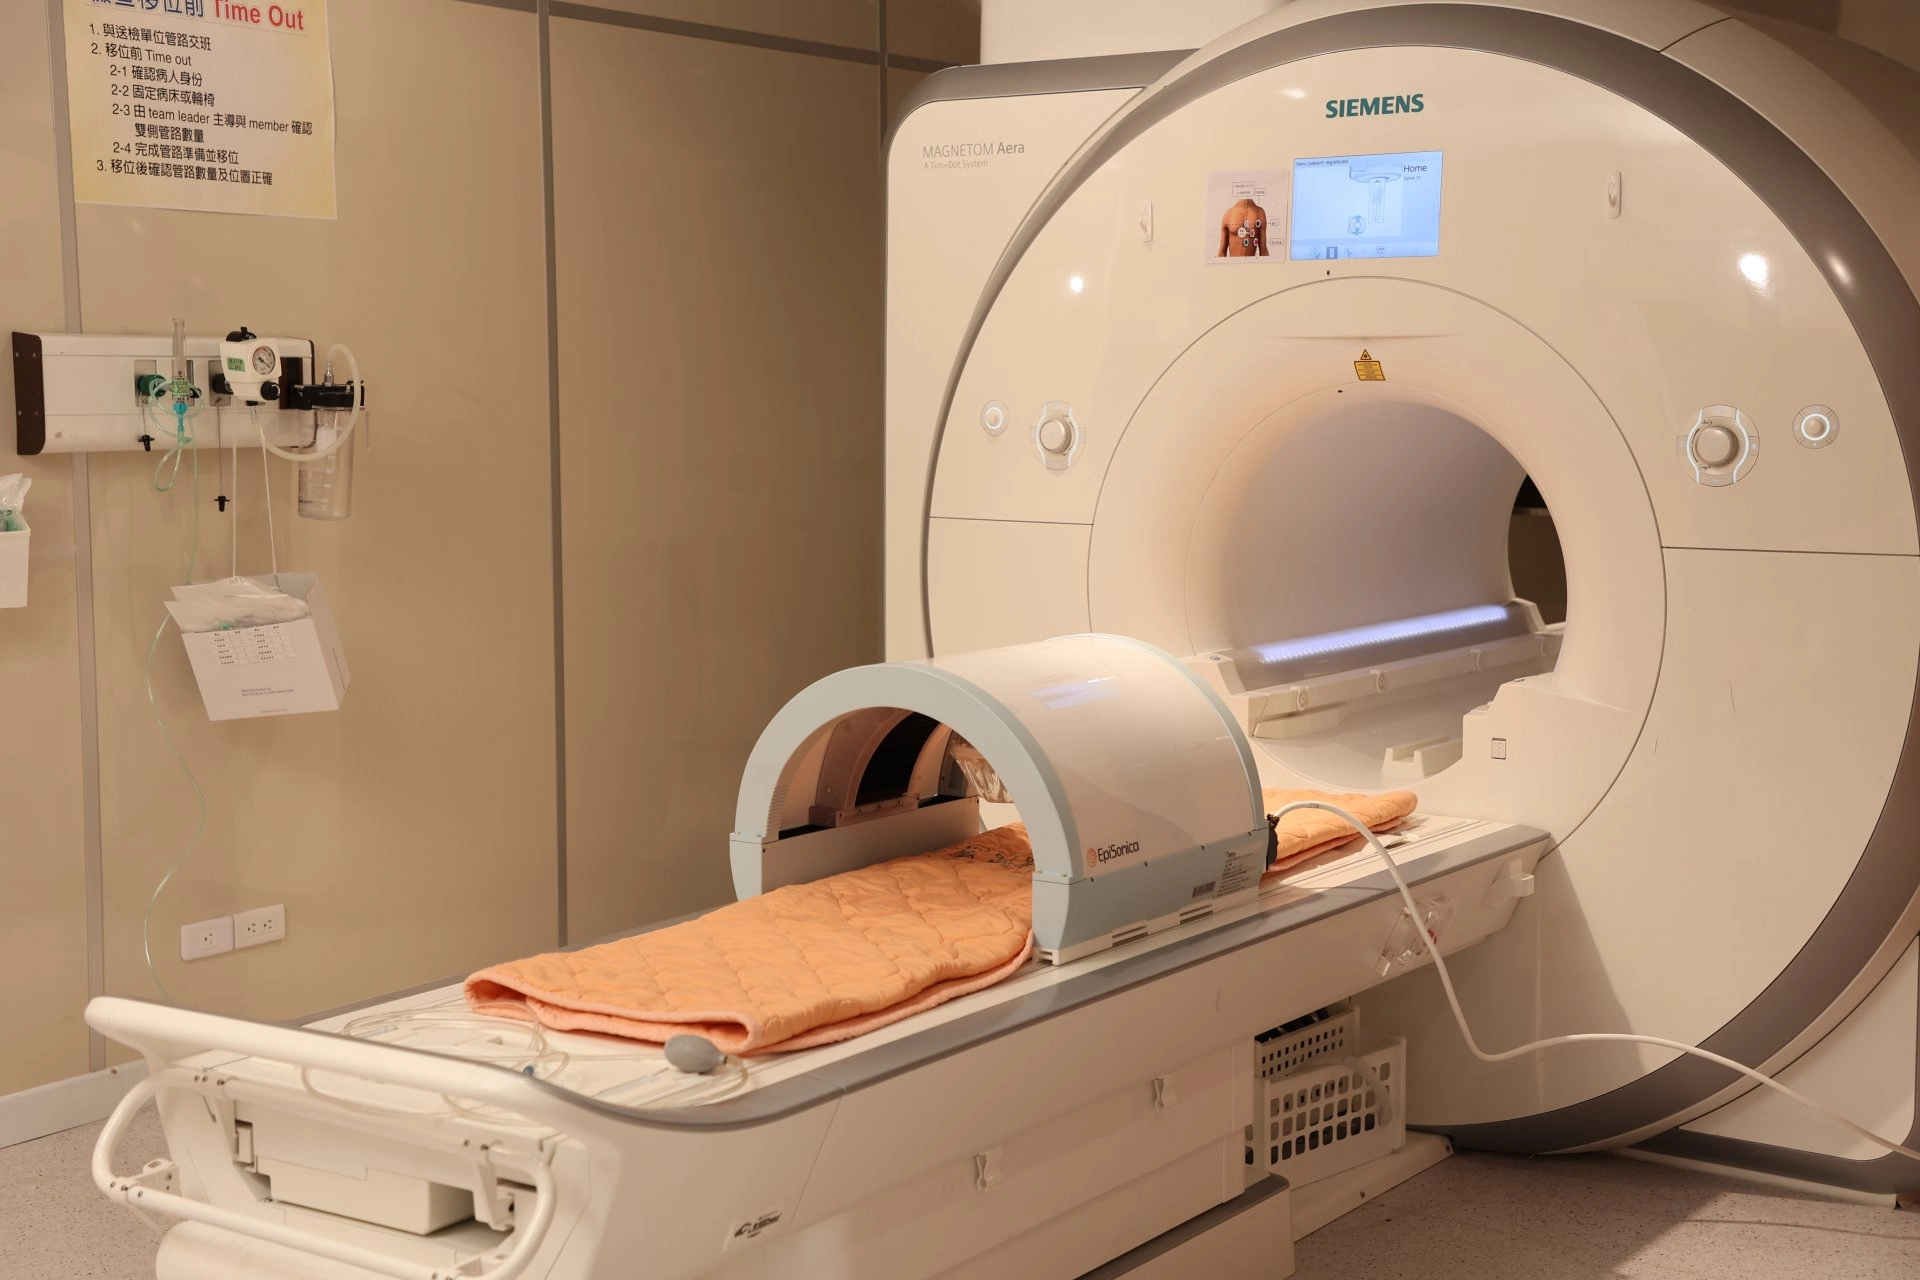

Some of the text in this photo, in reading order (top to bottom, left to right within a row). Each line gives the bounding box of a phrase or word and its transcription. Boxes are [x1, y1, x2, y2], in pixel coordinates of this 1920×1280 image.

[212, 0, 261, 23] Time
[268, 5, 304, 30] Out
[89, 23, 212, 51] 1. 與送檢單位管路交班
[91, 42, 192, 66] 2. 移位前 Time out
[110, 64, 202, 87] 2-1 確認病人身份
[111, 83, 215, 107] 2-2 固定病床或輪椅
[1325, 93, 1425, 119] SIEMENS
[112, 103, 313, 135] 2-3 由 team leader 主導與 member 確認
[134, 122, 205, 143] 雙側管路數量
[113, 141, 239, 165] 2-4 完成管路準備並移位
[922, 141, 1025, 159] MAGNETOM Aera
[96, 159, 273, 186] 3. 移位後確認管路數量及位置正確
[1403, 164, 1428, 173] Home
[1097, 840, 1140, 864] EpiSonica
